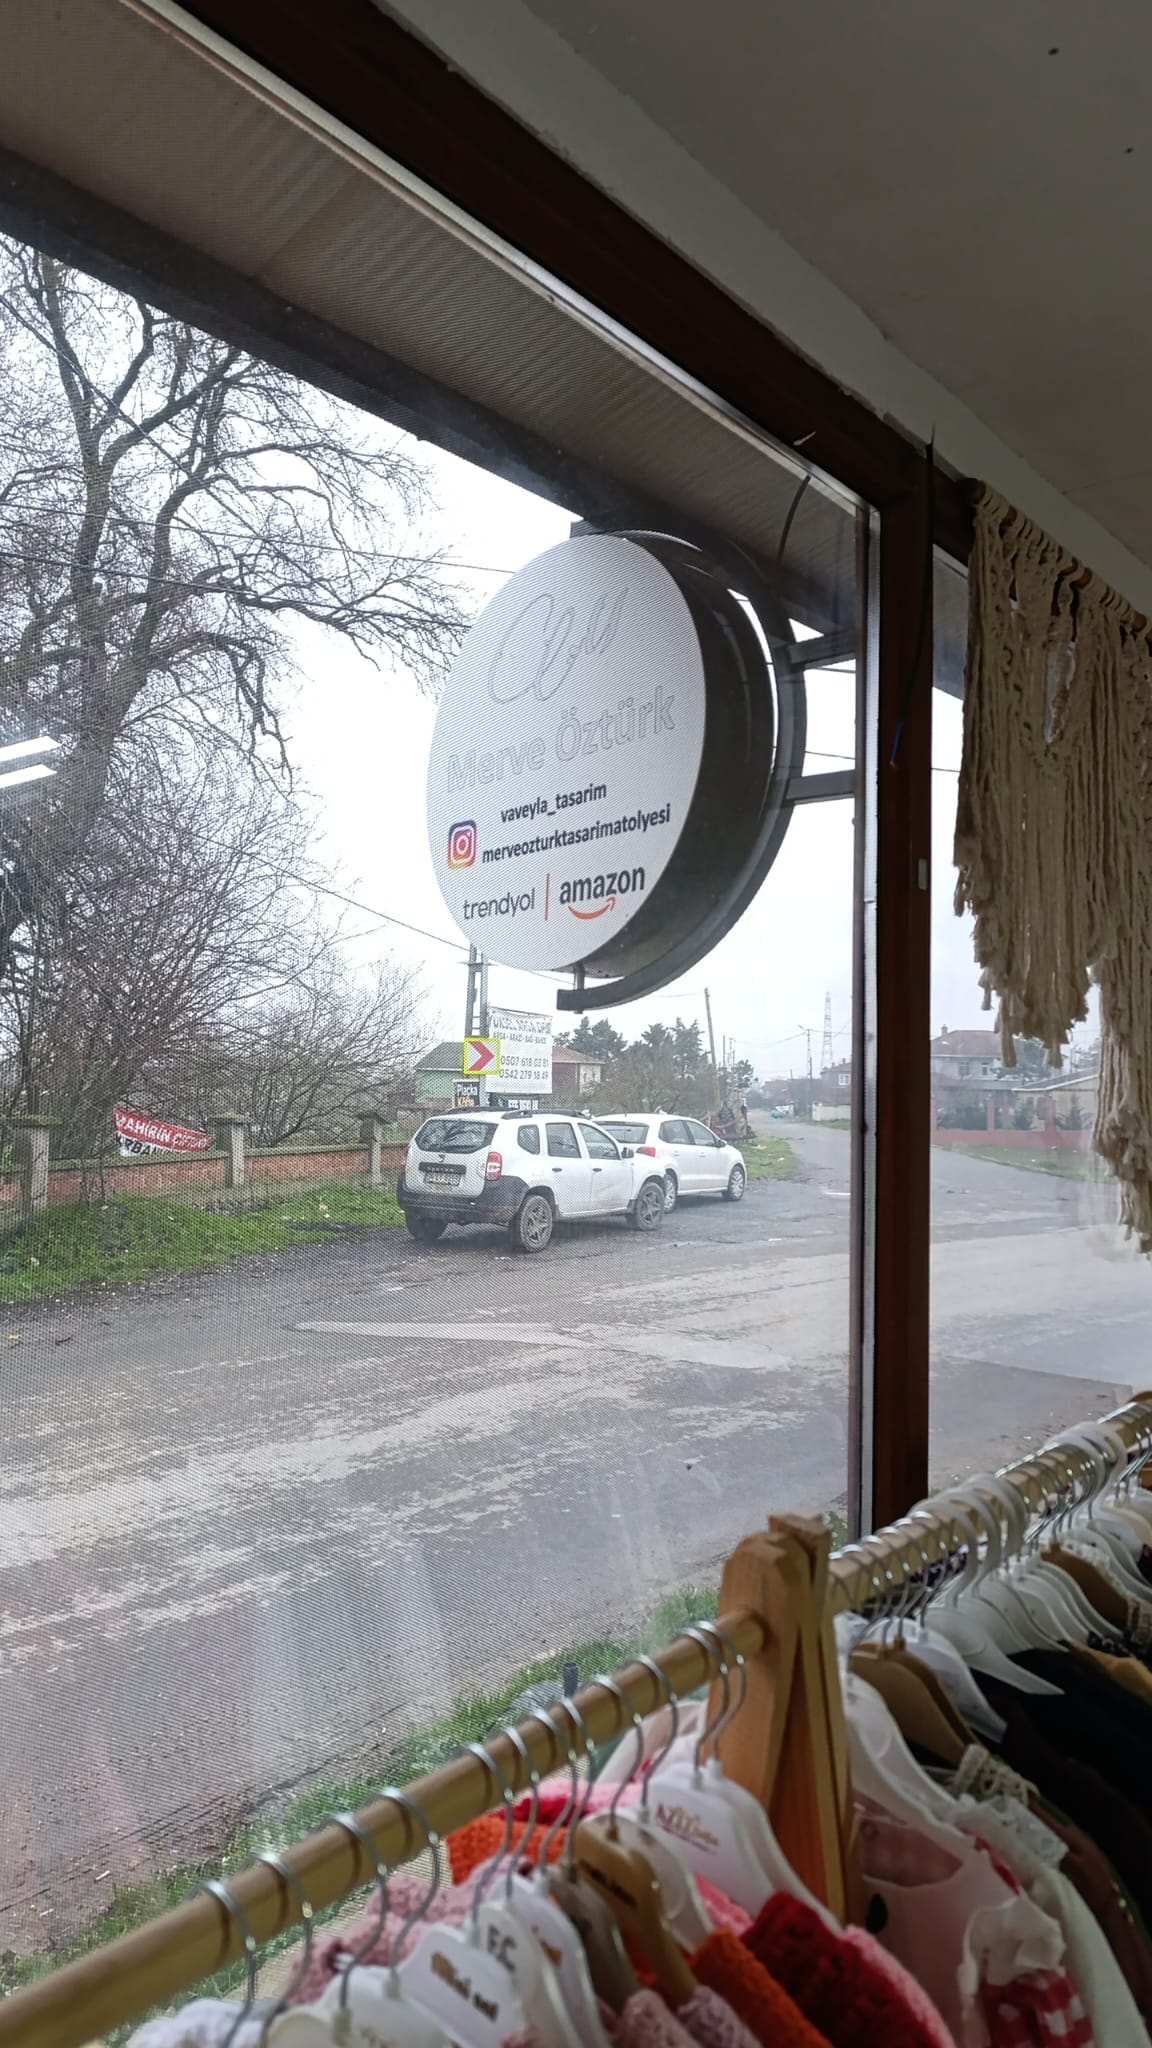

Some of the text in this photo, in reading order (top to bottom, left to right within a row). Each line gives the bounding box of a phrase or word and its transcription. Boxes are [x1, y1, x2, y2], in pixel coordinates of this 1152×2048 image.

[448, 685, 676, 794] Merve Öztürk
[500, 783, 608, 823] vaveyla_tasarim
[482, 803, 672, 863] merveozturktasarimatolyesi
[463, 866, 646, 921] trendyol amazon
[499, 1068, 519, 1080] 0542
